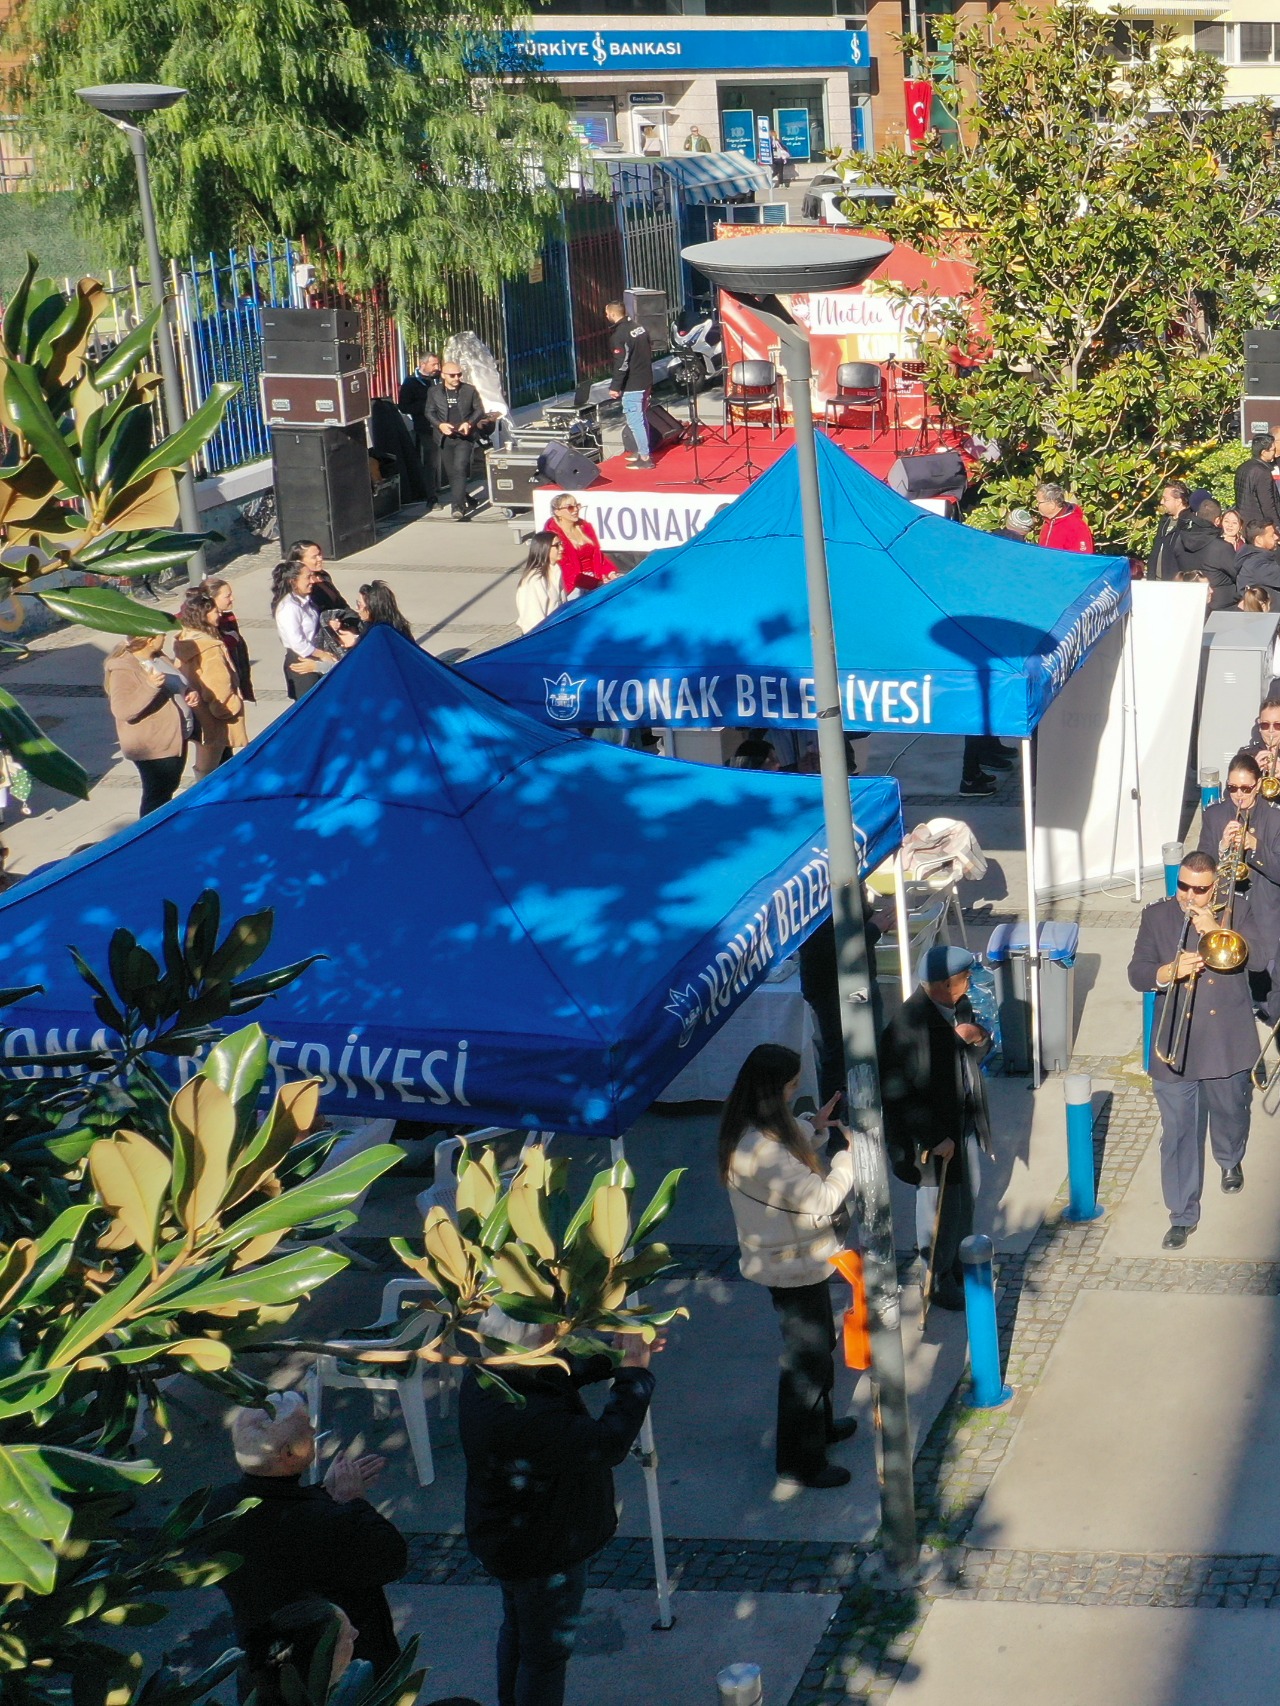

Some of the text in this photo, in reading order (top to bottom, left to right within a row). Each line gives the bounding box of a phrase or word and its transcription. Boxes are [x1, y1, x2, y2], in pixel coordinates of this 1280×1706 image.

[515, 38, 588, 56] TÜRKİYE
[609, 42, 681, 56] BANKASI
[817, 296, 883, 326] Mutlu
[596, 504, 702, 542] KONAK
[597, 673, 932, 724] KONAK BELEİYESİ
[699, 904, 774, 1025] KONAK
